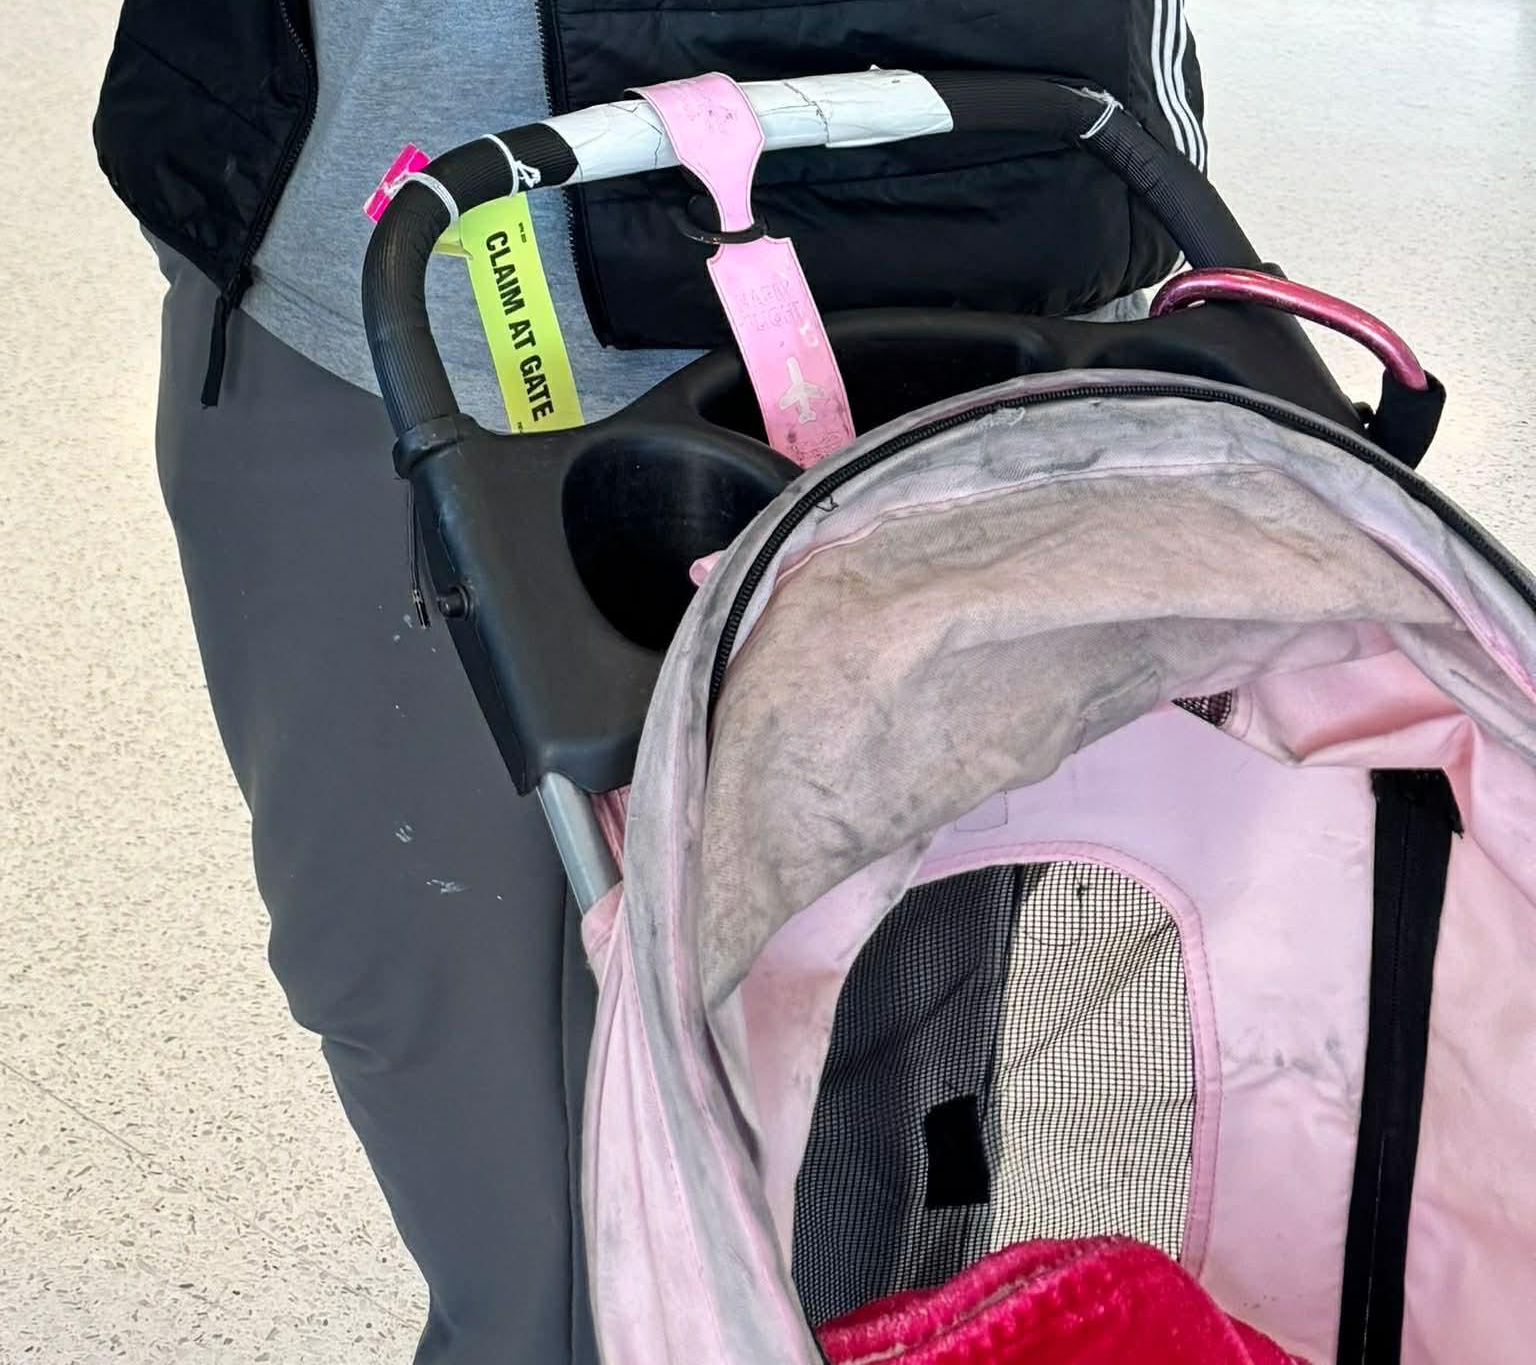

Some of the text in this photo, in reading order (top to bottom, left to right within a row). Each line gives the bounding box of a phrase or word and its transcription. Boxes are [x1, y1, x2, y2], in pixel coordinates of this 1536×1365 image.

[486, 230, 555, 422] CLAIM AT GATE
